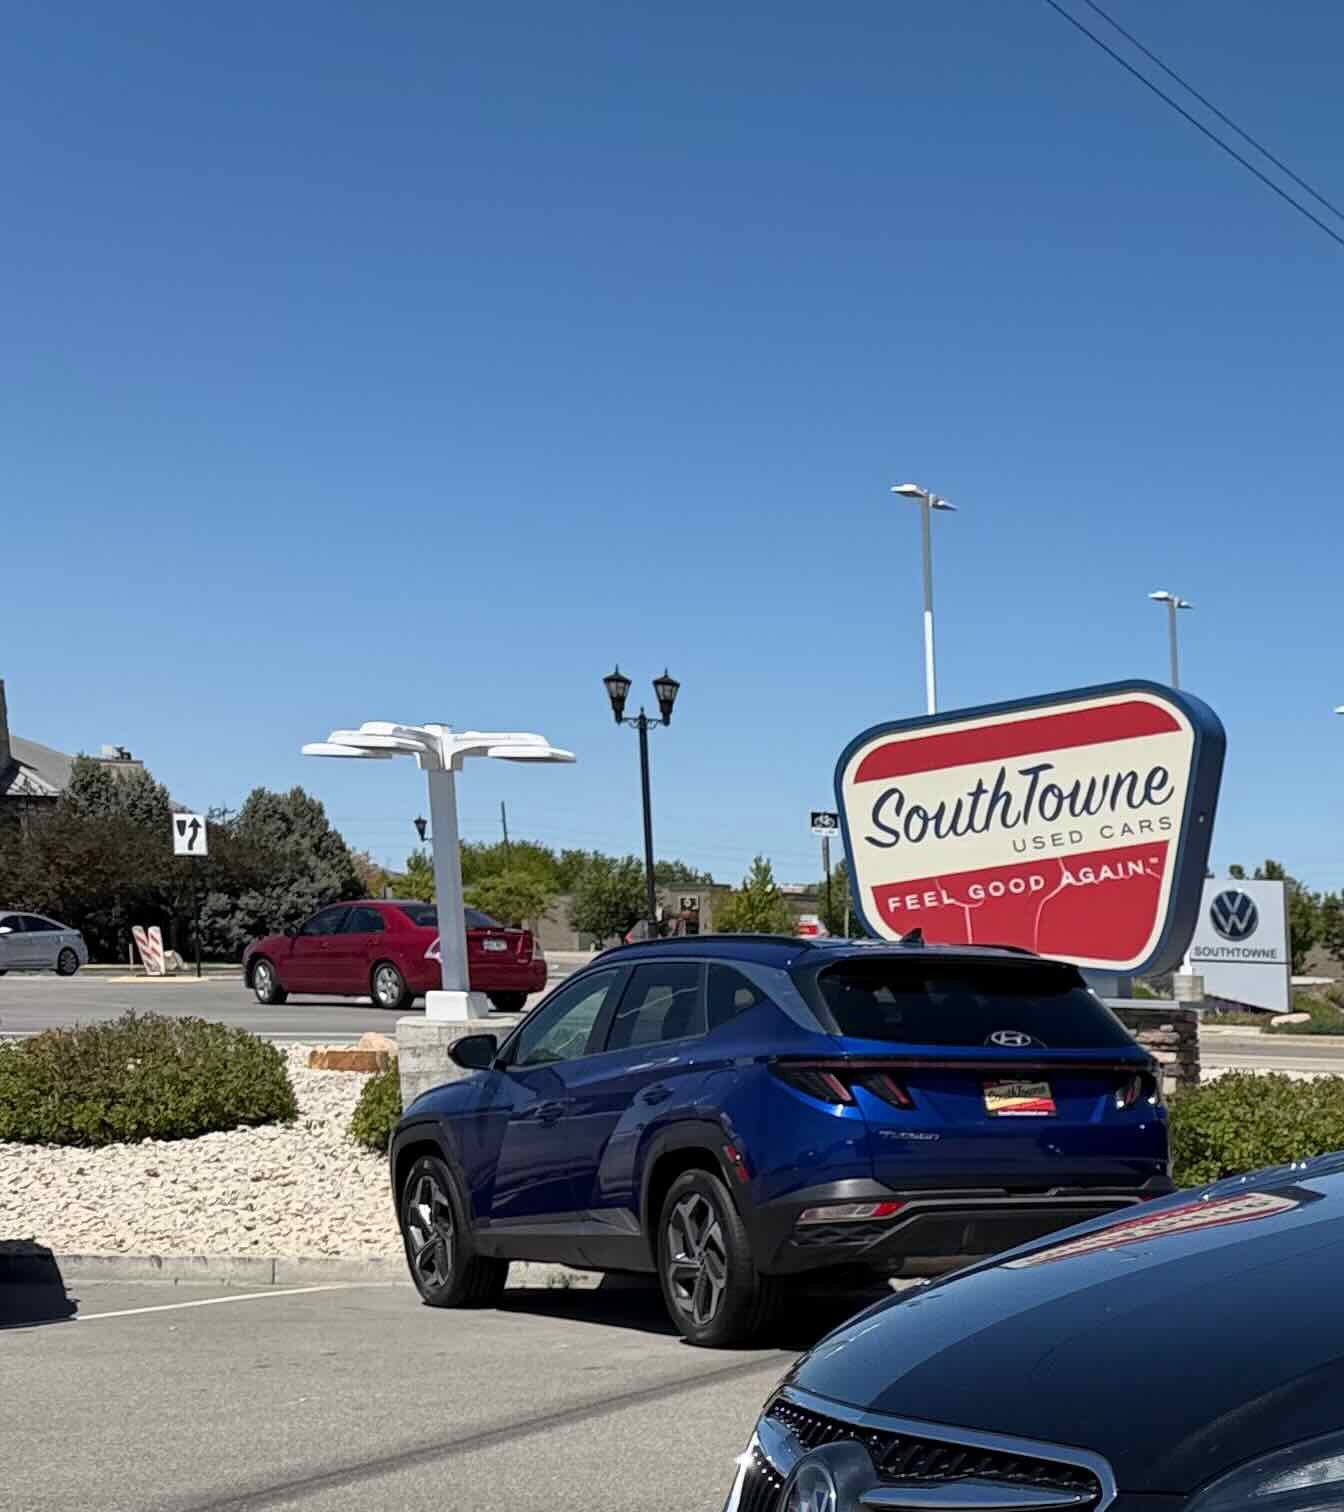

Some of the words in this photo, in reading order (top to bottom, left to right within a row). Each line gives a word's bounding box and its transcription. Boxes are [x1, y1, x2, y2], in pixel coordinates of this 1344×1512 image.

[865, 763, 1175, 848] SouthTowne
[1012, 830, 1084, 853] USED
[1100, 816, 1172, 839] CARS
[888, 889, 955, 912] FEEL
[968, 875, 1045, 899] GOOD
[1194, 945, 1278, 959] SOUTHTOWNE
